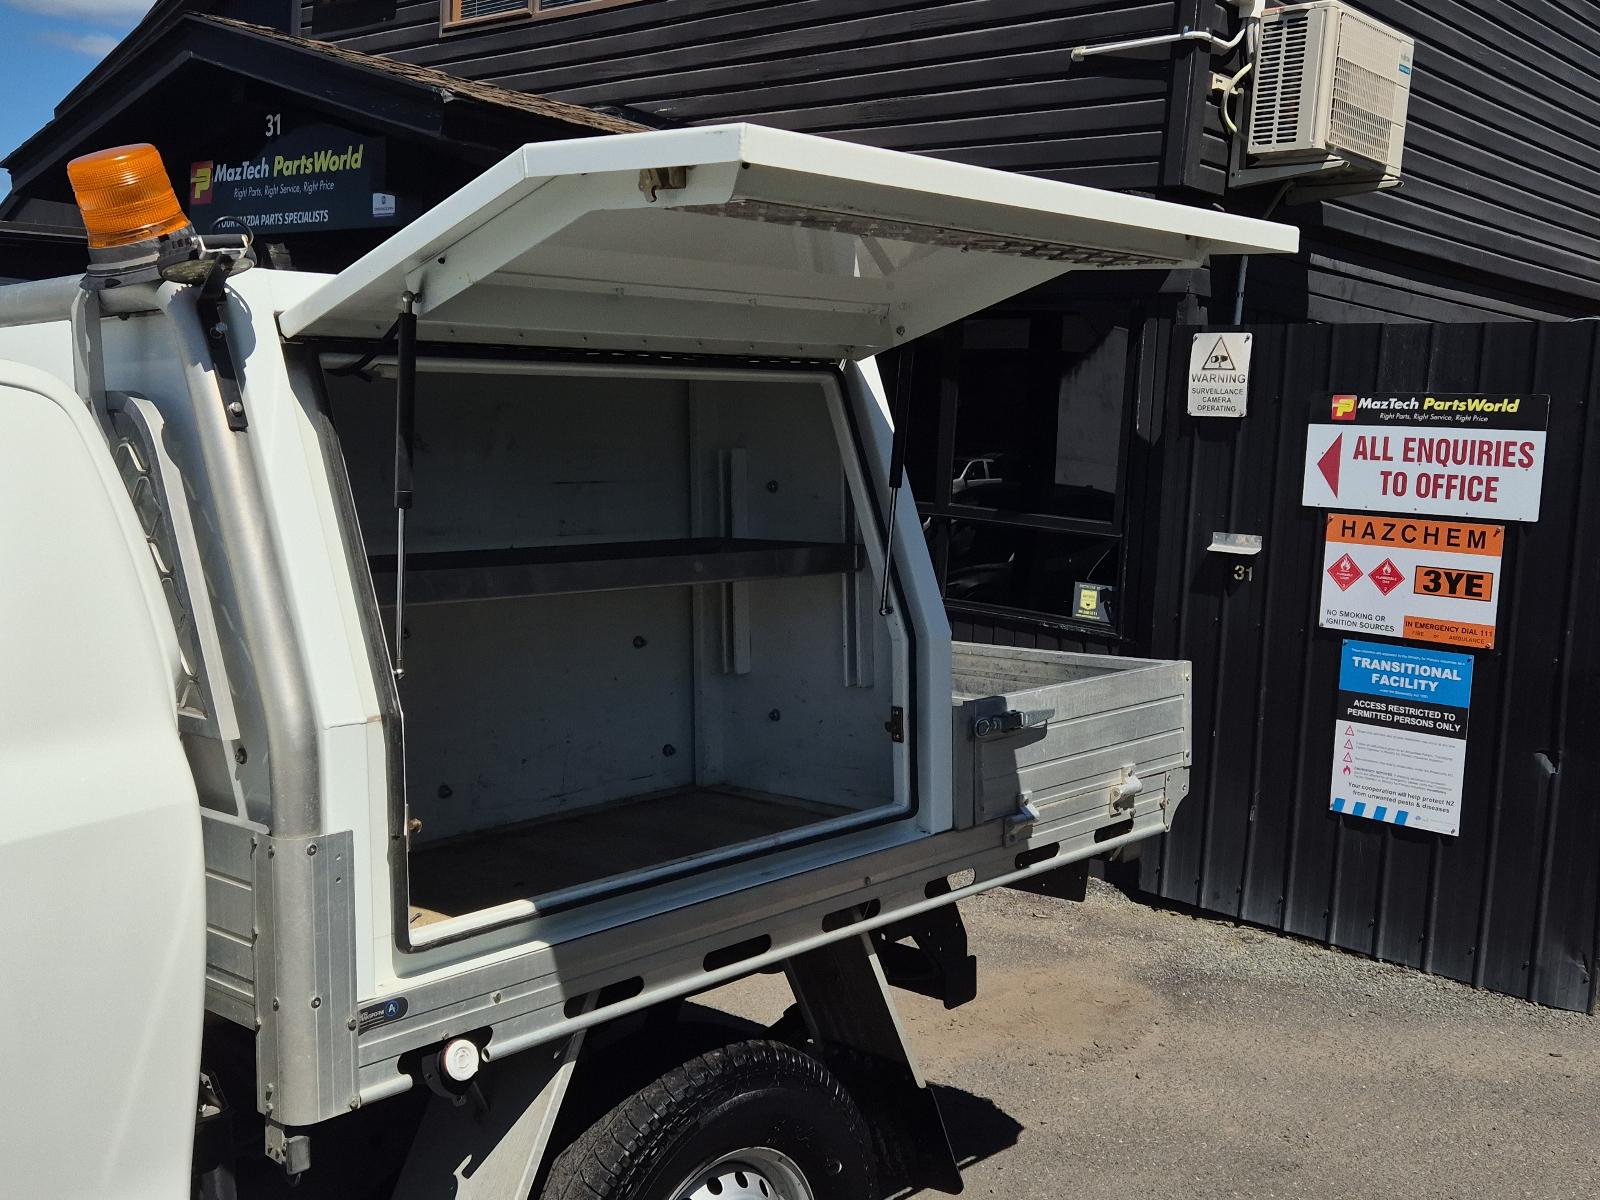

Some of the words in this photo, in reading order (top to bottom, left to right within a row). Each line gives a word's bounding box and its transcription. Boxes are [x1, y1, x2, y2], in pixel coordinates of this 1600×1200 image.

[265, 113, 281, 137] 31
[214, 157, 269, 183] MazTech
[273, 144, 364, 177] PartsWorld
[234, 188, 248, 201] Right
[264, 184, 279, 198] Right
[280, 183, 302, 194] Service,
[303, 181, 319, 195] Right
[319, 180, 335, 191] Price
[261, 212, 283, 226] PARTS
[284, 209, 329, 224] SPECIALISTS
[1191, 373, 1246, 384] WARNING
[1191, 387, 1244, 395] SURVEILLANCE
[1196, 404, 1237, 412] OPERATING
[1358, 397, 1419, 410] MazTech
[1422, 397, 1520, 413] PartsWorld
[1379, 412, 1395, 421] Right
[1395, 413, 1411, 421] Parts,
[1413, 413, 1429, 422] Right
[1429, 413, 1454, 422] Service,
[1455, 414, 1471, 423] Right
[1472, 414, 1489, 422] Price
[1352, 435, 1394, 462] ALL
[1402, 437, 1535, 470] ENQUIRIES
[1380, 470, 1407, 497] TO
[1415, 472, 1500, 503] OFFICE
[1341, 519, 1487, 550] HAZCHEM
[1233, 564, 1253, 582] 31
[1422, 569, 1484, 598] 3YE
[1325, 617, 1357, 627] IGNITION
[1359, 621, 1395, 632] SOURCES
[1326, 609, 1337, 617] NO
[1339, 610, 1373, 622] SMOKING
[1375, 614, 1386, 623] OR
[1414, 622, 1460, 633] EMERGENCY
[1461, 627, 1478, 636] DIAL
[1448, 635, 1485, 645] AMBULANCE
[1351, 655, 1462, 681] TRANSITIONAL
[1371, 673, 1440, 692] FACILITY
[1347, 707, 1392, 722] PERMITTED
[1393, 715, 1434, 729] PERSONS
[1435, 721, 1461, 733] ONLY
[1353, 699, 1387, 712] ACCESS
[1387, 705, 1441, 719] RESTRICTED
[1442, 711, 1456, 721] TO
[1348, 781, 1361, 790] Your
[1361, 783, 1397, 796] cooperation
[1407, 792, 1421, 801] help
[1422, 795, 1445, 805] protect
[1352, 789, 1367, 798] from
[1367, 793, 1397, 804] unwanted
[1397, 799, 1415, 808] pests
[1421, 803, 1450, 814] diseases
